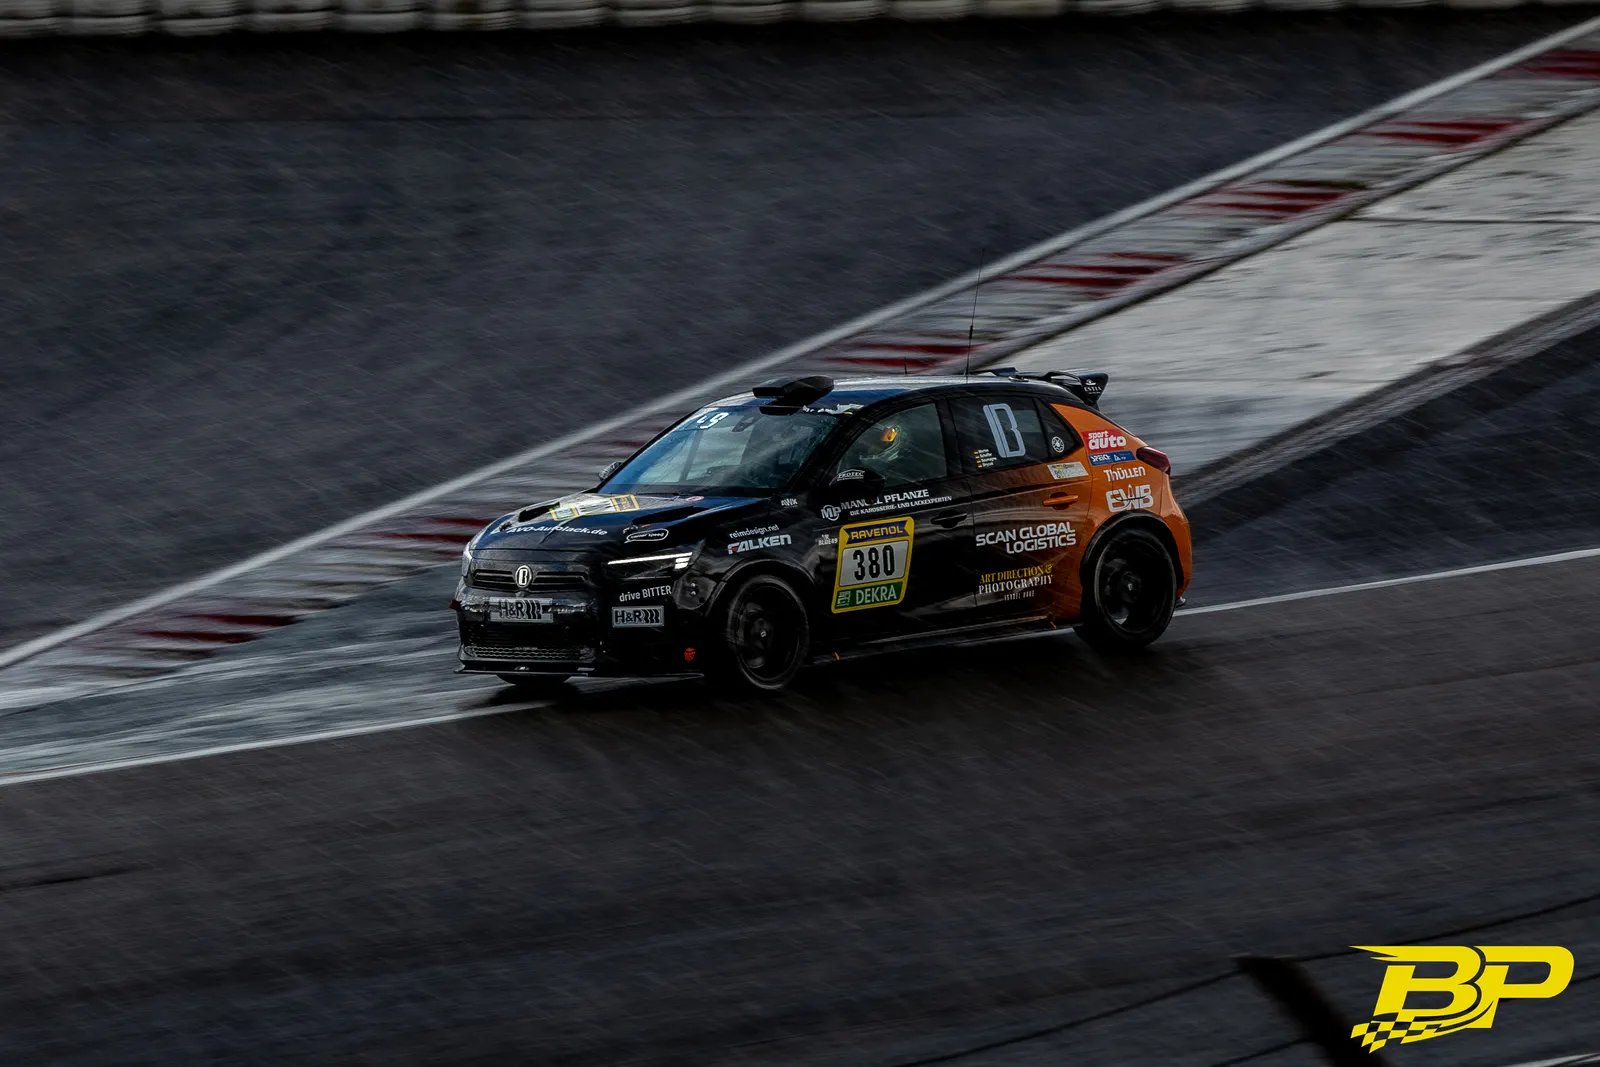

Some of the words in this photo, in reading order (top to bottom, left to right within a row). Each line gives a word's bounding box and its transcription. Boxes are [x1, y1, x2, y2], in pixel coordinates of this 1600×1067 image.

[1088, 430, 1109, 440] sport
[1088, 435, 1127, 450] auto
[884, 489, 929, 503] PFLANZE
[1105, 484, 1154, 513] EWB
[729, 524, 780, 539] reimdesign.net
[850, 526, 903, 540] RAVENOL
[976, 529, 1016, 547] SCAN
[1019, 521, 1076, 540] GLOBAL
[727, 534, 792, 555] FALKEN
[1006, 533, 1077, 554] LOGISTICS
[853, 545, 895, 581] 380
[980, 572, 996, 584] ART
[997, 567, 1044, 581] DIRECTION
[1045, 563, 1053, 574] &
[619, 591, 641, 603] drive
[642, 585, 672, 600] BITTER
[856, 584, 897, 605] DEKRA
[978, 574, 1054, 595] PHOTOGRAPHY
[500, 599, 525, 619] H&R
[614, 609, 644, 625] H&R
